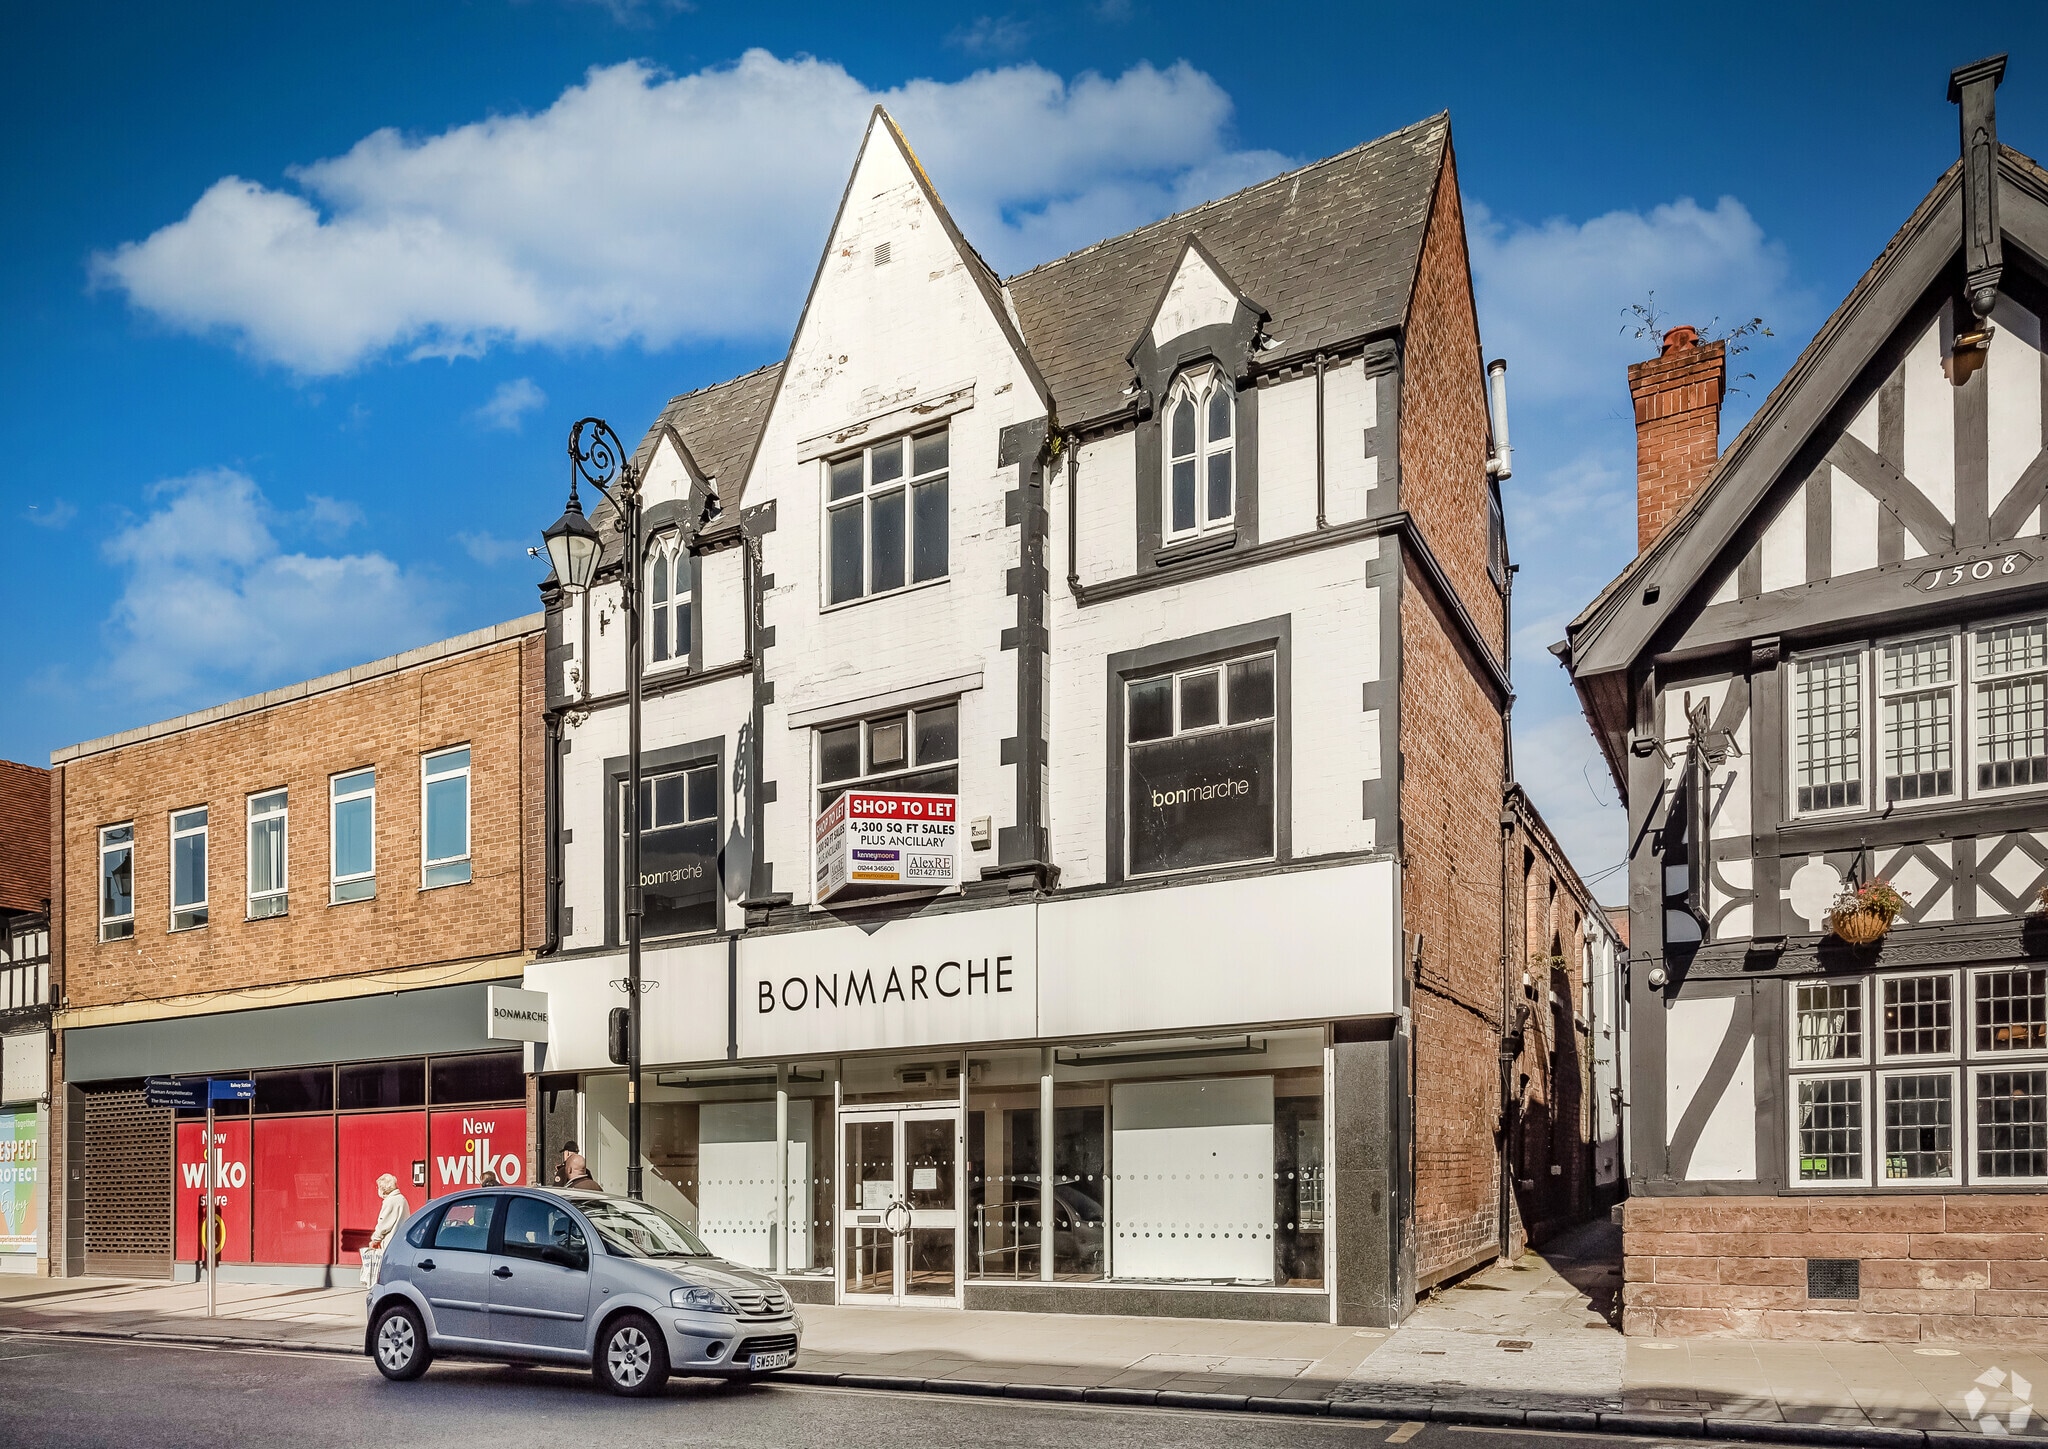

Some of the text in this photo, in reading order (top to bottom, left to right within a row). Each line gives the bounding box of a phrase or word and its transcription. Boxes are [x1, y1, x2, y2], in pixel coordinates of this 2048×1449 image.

[1925, 553, 2020, 590] 1508
[1152, 778, 1249, 807] bonmarche
[853, 799, 953, 817] SHOP TO LET
[816, 802, 845, 838] SHOP TO LET
[850, 821, 955, 835] 4,300 SQ FT SALES
[860, 835, 945, 847] PLUS ANCILLARY
[857, 851, 895, 860] kenneymoore
[909, 856, 951, 869] AlexRE
[640, 862, 703, 886] bonmarché
[908, 868, 923, 876] 0121
[937, 869, 951, 877] 1315
[758, 955, 1013, 1014] BONMARCHE
[494, 1007, 547, 1022] BONMARCHE
[463, 1117, 495, 1135] New
[436, 1138, 521, 1185] wilko
